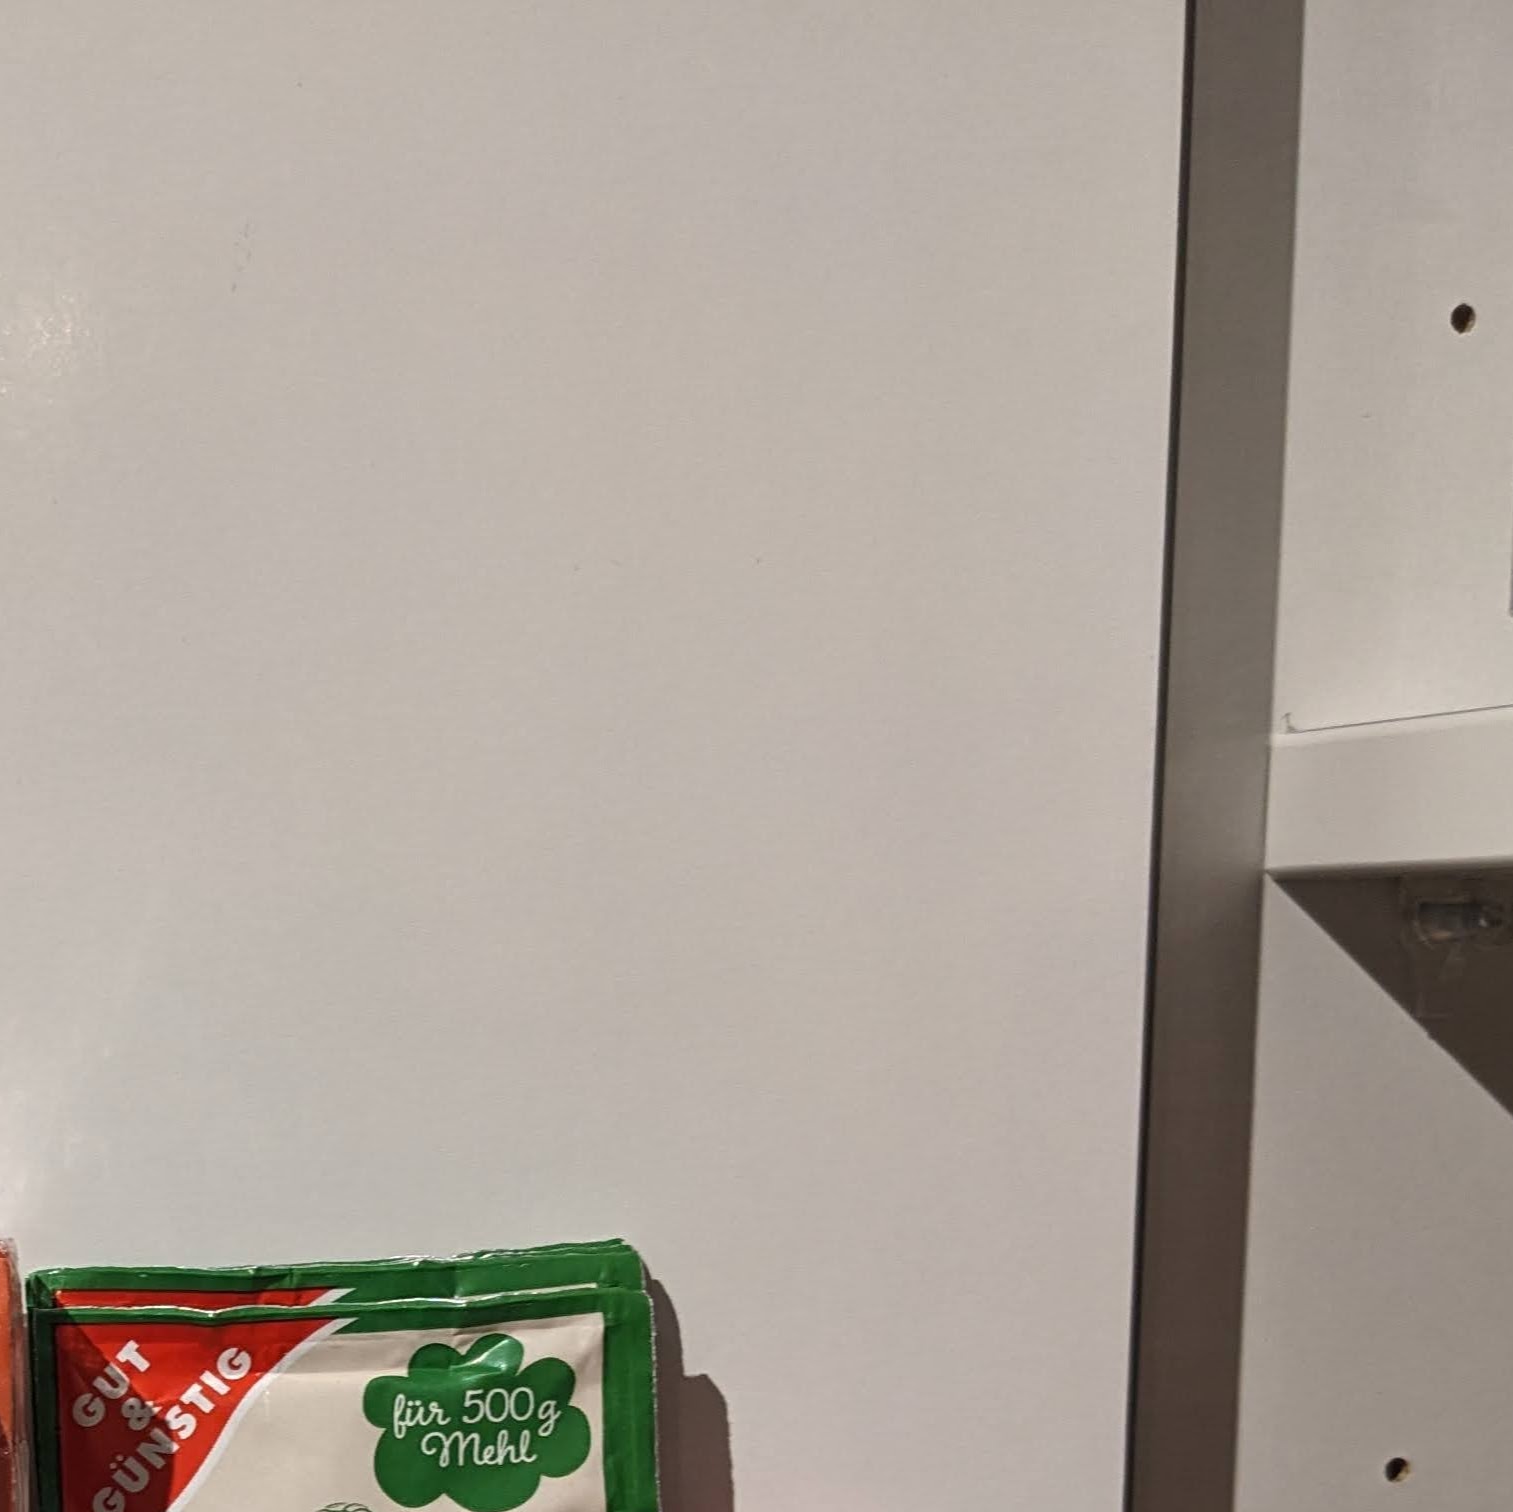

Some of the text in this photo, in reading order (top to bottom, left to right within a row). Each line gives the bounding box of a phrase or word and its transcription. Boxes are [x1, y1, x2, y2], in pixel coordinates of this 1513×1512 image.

[72, 1340, 151, 1427] GUT
[121, 1397, 162, 1431] &
[393, 1393, 451, 1439] für
[420, 1429, 538, 1468] Mehl
